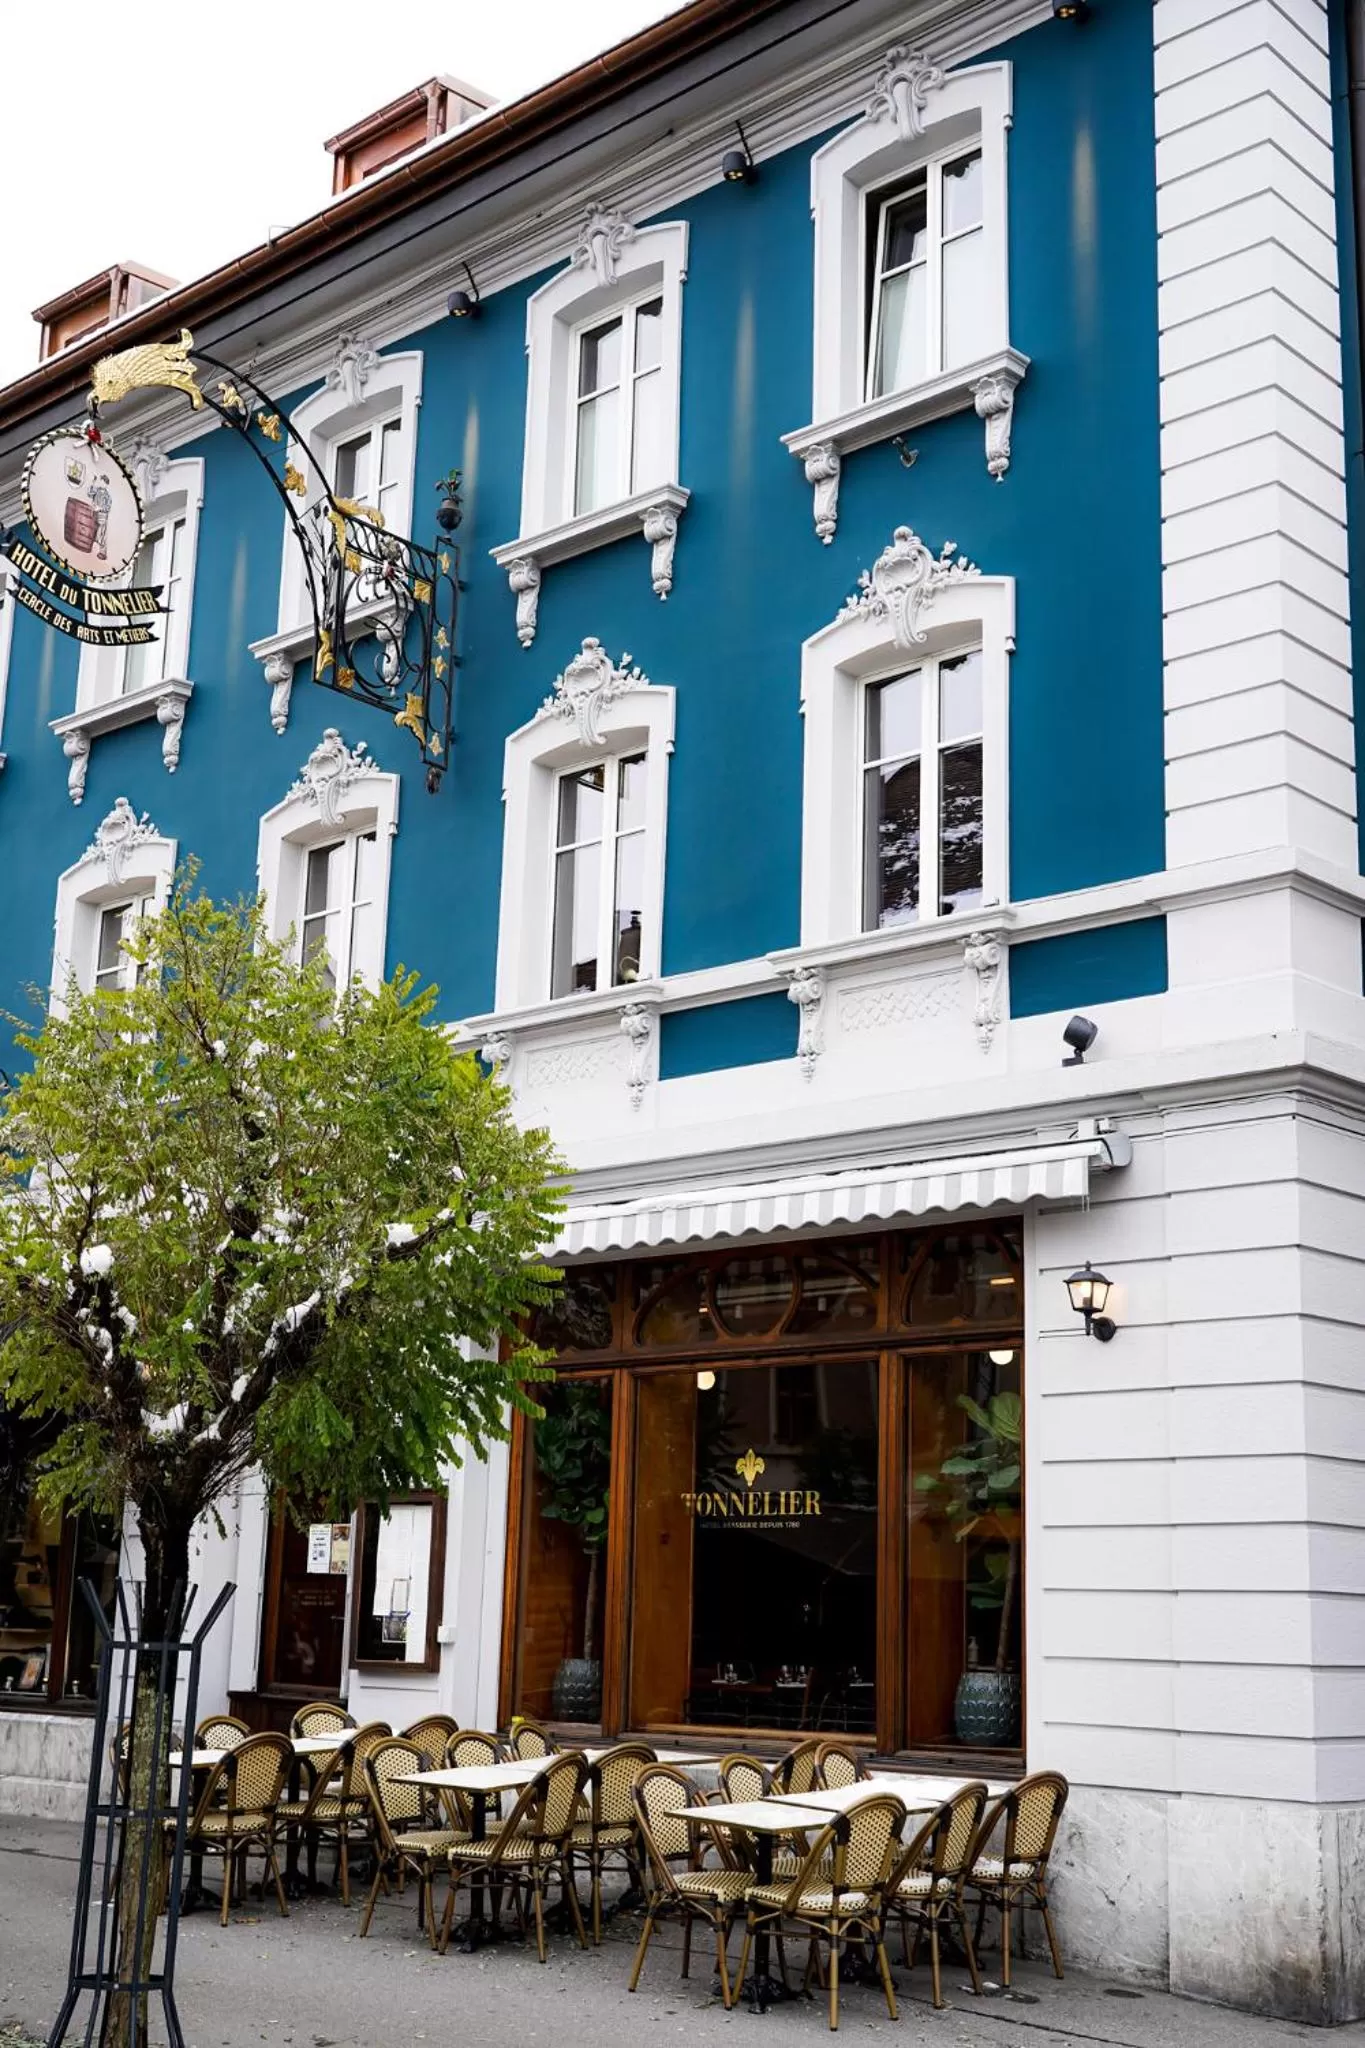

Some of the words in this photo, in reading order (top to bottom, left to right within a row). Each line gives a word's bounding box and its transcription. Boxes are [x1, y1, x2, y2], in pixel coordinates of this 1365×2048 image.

[11, 544, 57, 593] HOTEL
[61, 584, 78, 605] DU
[82, 589, 158, 614] TONNELIER
[18, 587, 52, 618] CERCLE
[53, 613, 72, 632] DES
[77, 625, 100, 642] ARTS
[104, 630, 114, 644] ET
[681, 1490, 822, 1516] TONNELIER
